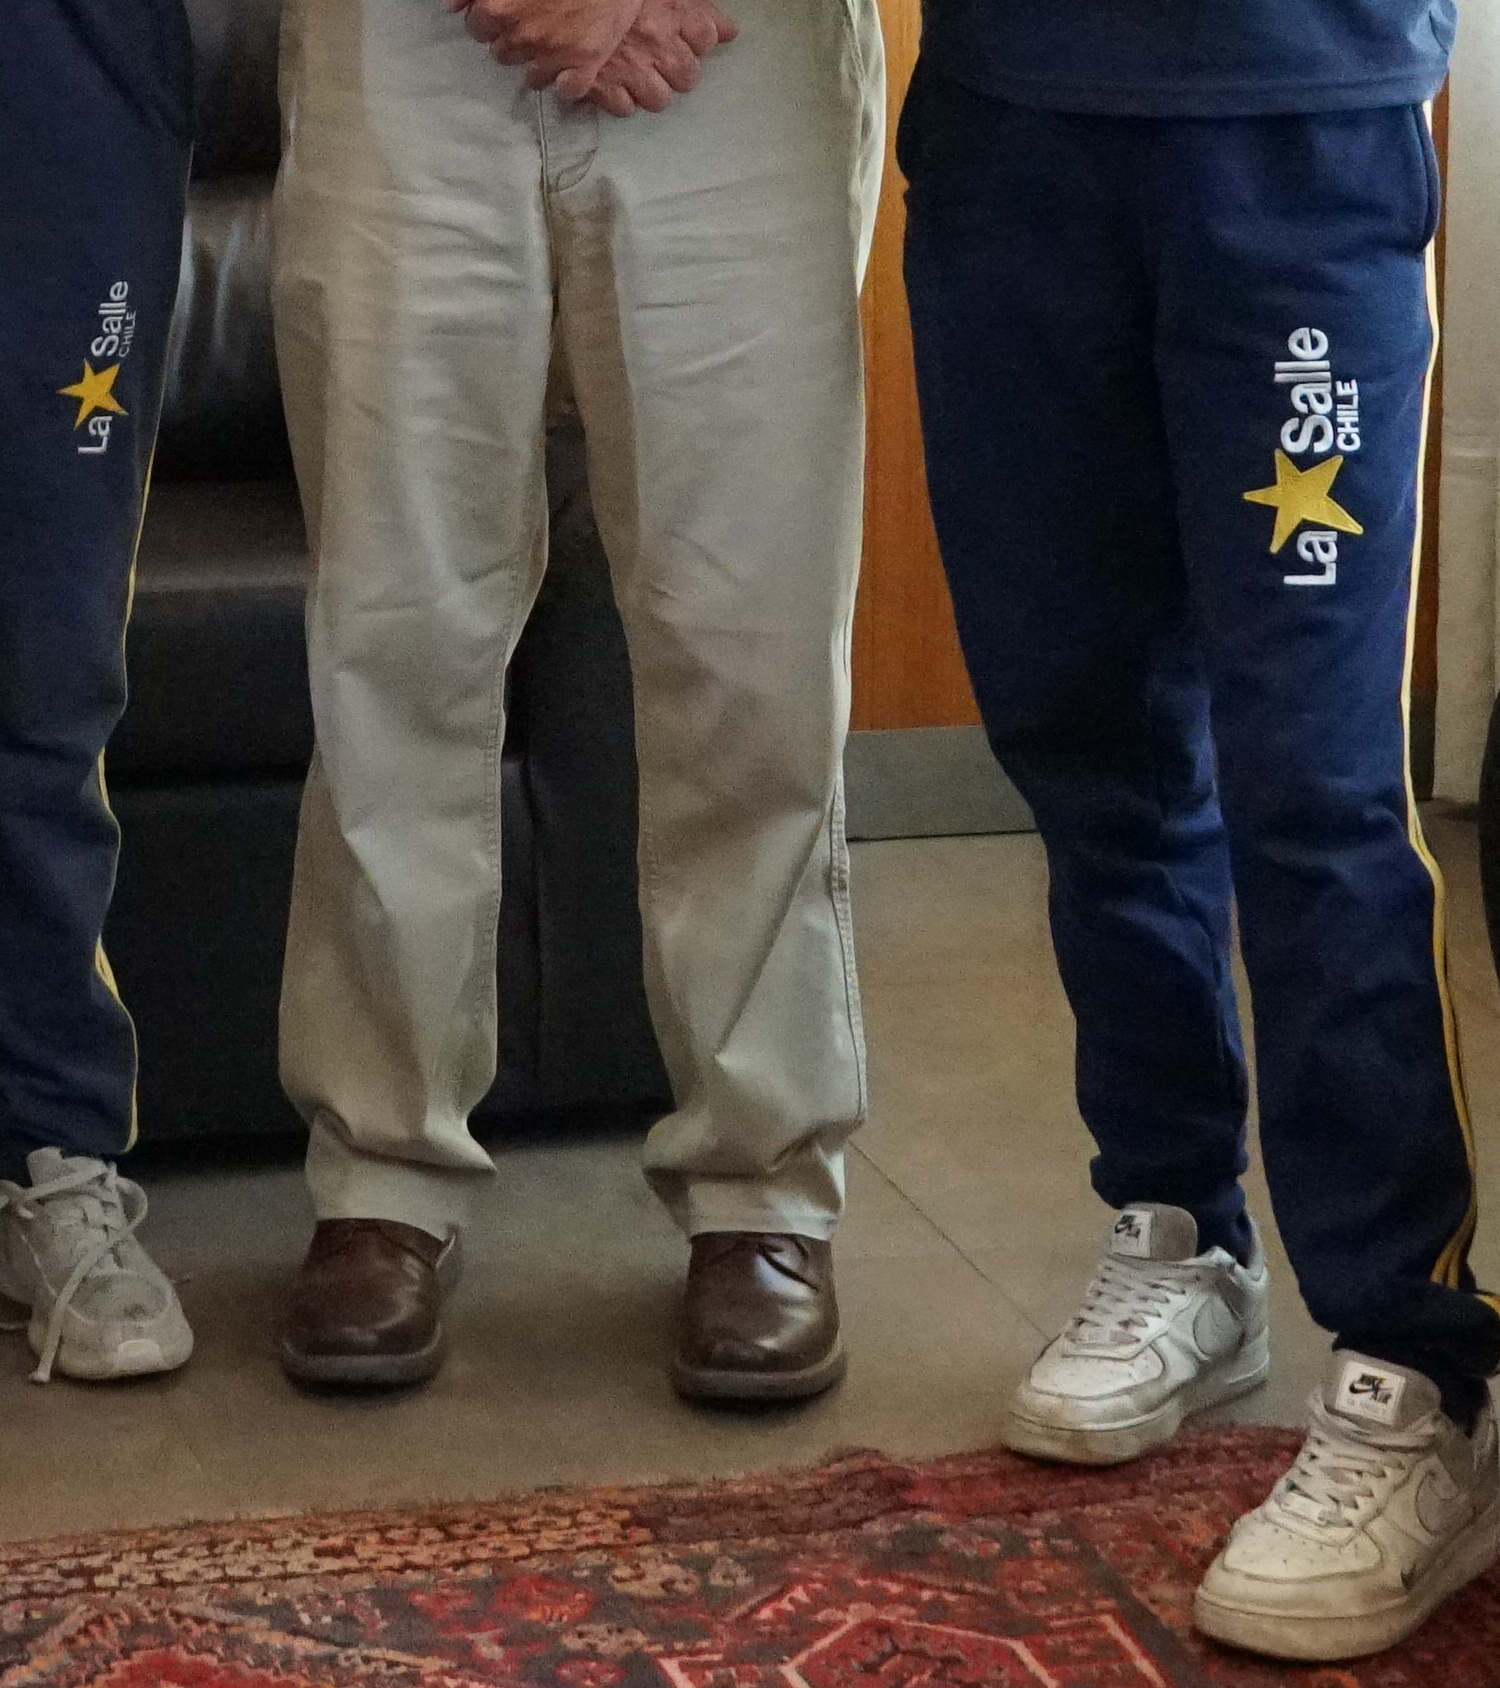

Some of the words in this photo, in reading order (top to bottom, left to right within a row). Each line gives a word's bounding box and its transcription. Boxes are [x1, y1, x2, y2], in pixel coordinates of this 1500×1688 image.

[91, 280, 129, 357] Salle
[118, 310, 137, 358] CHILE
[1274, 326, 1334, 453] Salle
[1336, 379, 1361, 452] CHILE
[78, 415, 114, 454] La
[1283, 530, 1339, 587] La
